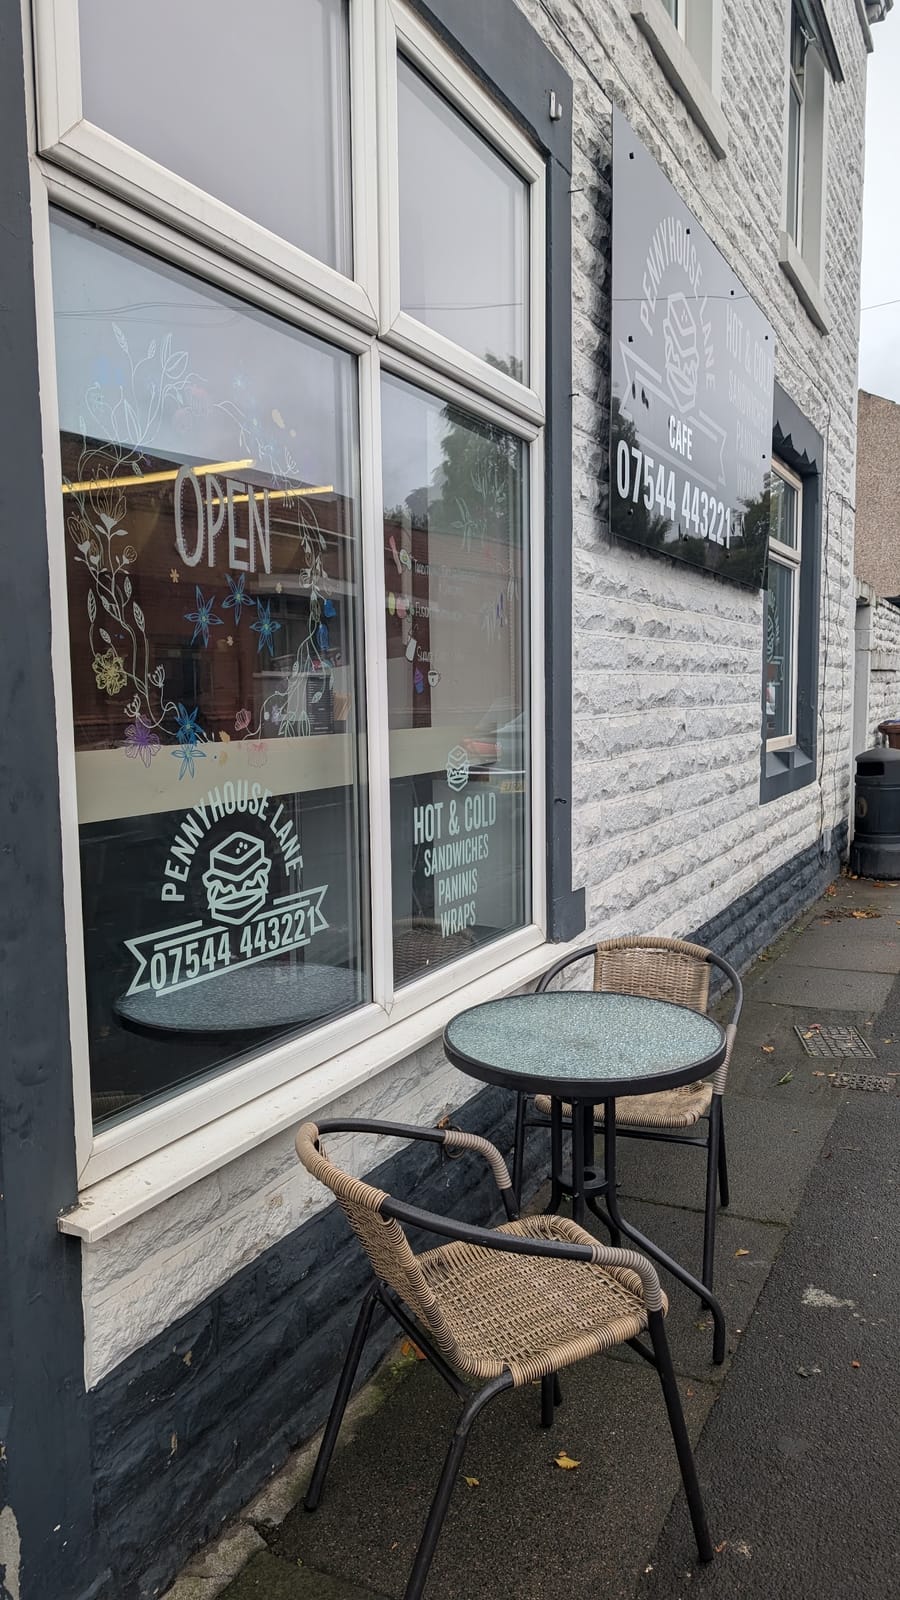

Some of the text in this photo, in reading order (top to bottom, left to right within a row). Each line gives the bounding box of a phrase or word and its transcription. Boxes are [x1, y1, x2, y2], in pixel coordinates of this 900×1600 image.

[726, 303, 743, 364] HOT
[669, 414, 693, 461] CAFE
[173, 464, 273, 575] OPEN
[616, 440, 731, 549] 07544 443221
[161, 779, 304, 902] PENNYHOUSE LANE
[413, 792, 496, 845] HOT & COLD
[424, 833, 489, 877] SANDWICHES
[438, 867, 478, 906] PANINIS
[150, 905, 316, 990] 07544 443221
[440, 900, 477, 939] WRAPS
